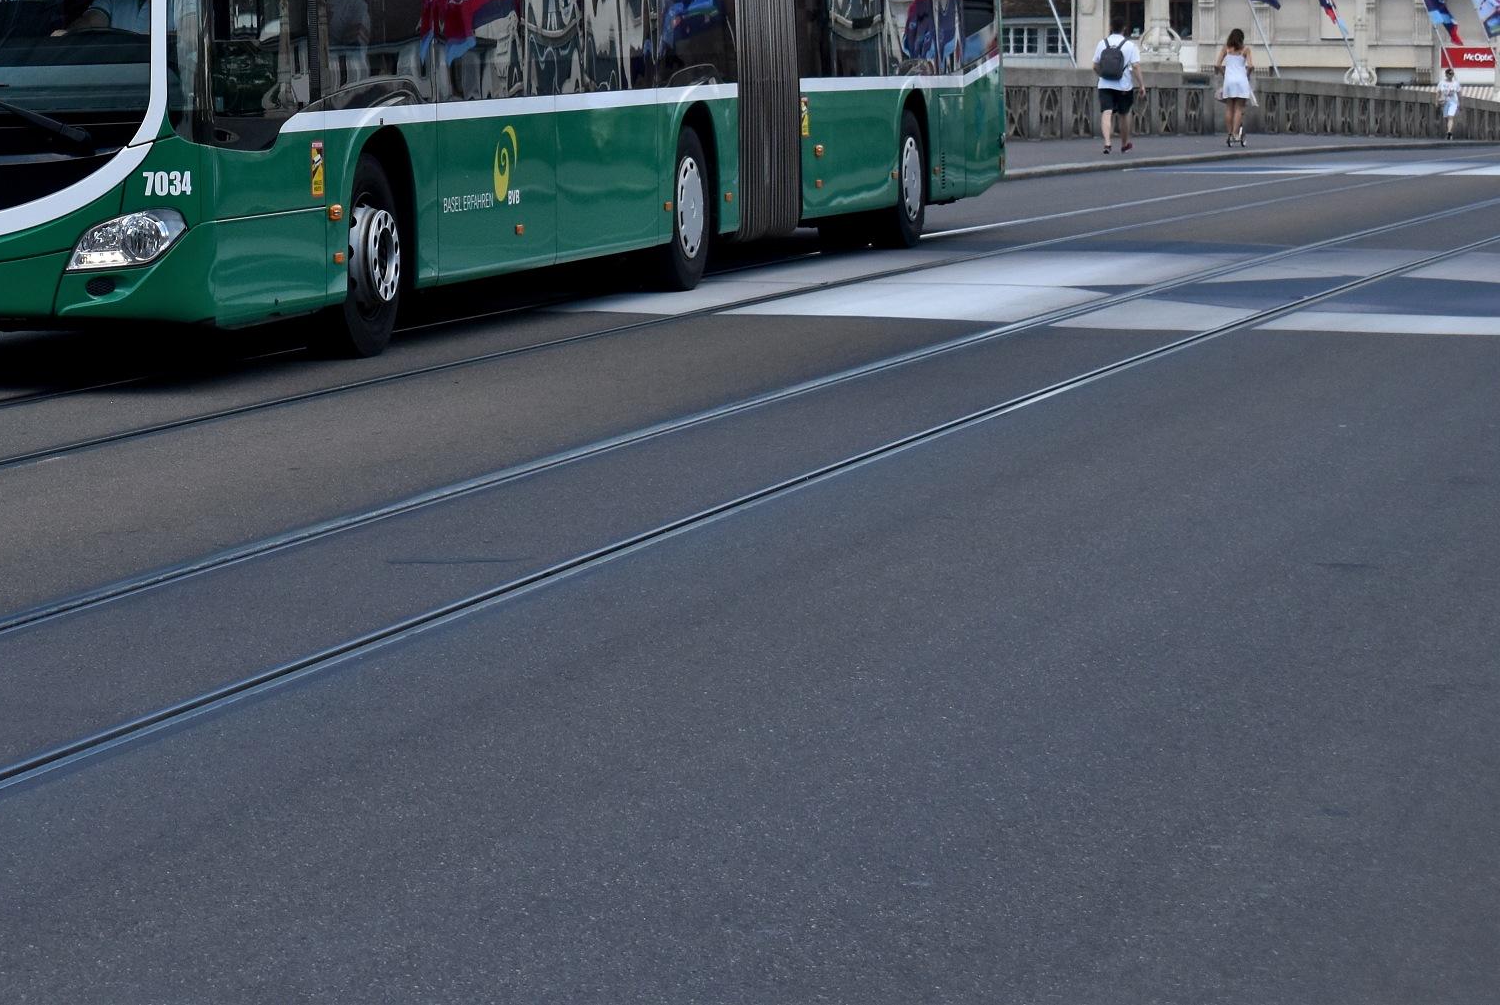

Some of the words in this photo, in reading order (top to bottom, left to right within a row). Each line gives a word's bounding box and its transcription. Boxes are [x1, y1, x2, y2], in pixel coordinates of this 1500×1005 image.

[142, 171, 192, 196] 7034
[443, 196, 462, 213] BASEL
[463, 192, 494, 211] ERFAHREN
[508, 189, 520, 205] BVB
